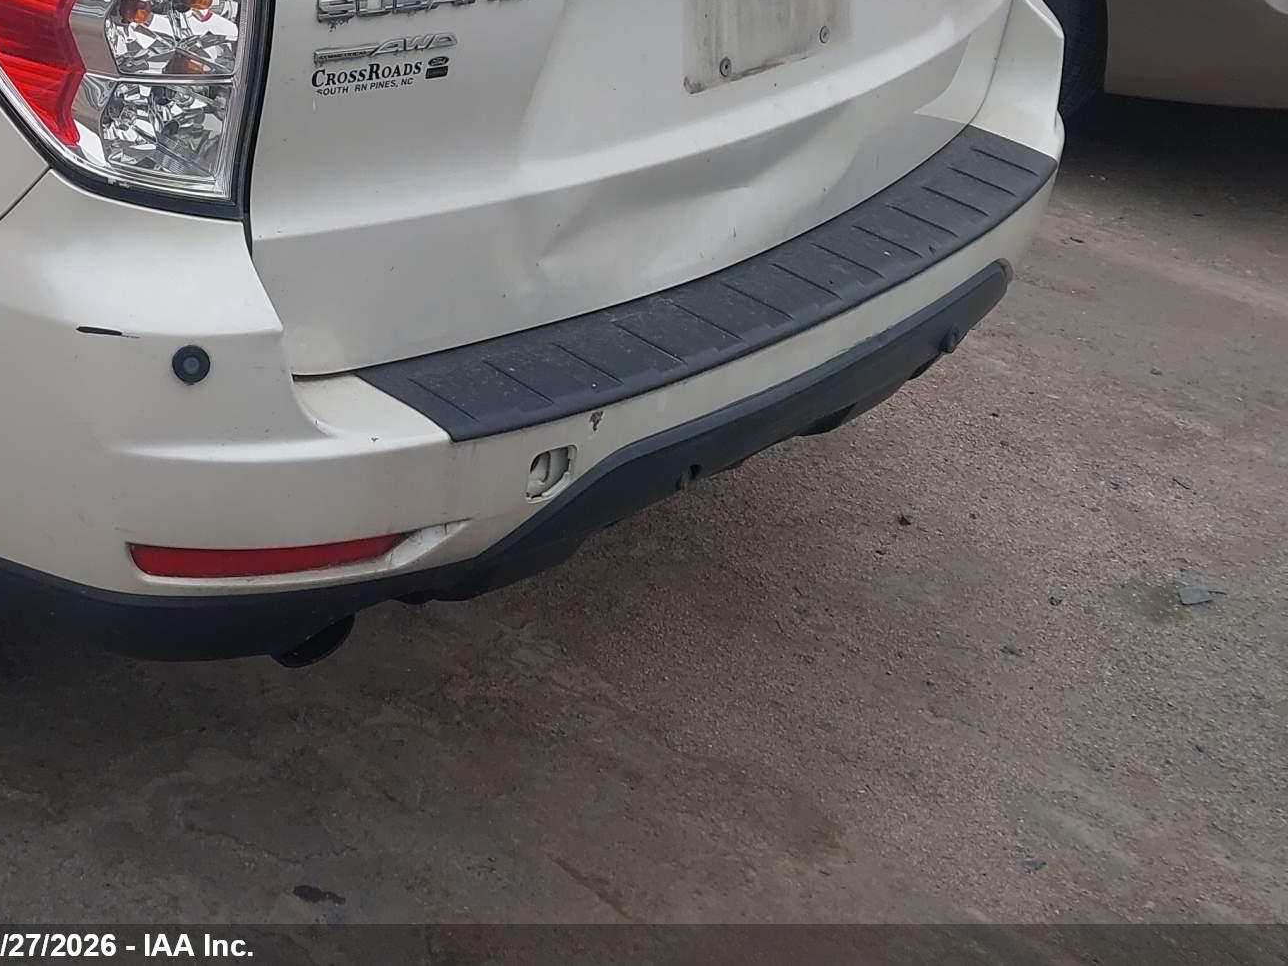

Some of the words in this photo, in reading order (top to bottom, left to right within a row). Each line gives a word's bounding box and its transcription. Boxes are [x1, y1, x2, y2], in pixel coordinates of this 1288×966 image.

[369, 32, 458, 58] AWD
[369, 79, 399, 91] PINES,
[400, 77, 414, 86] NC
